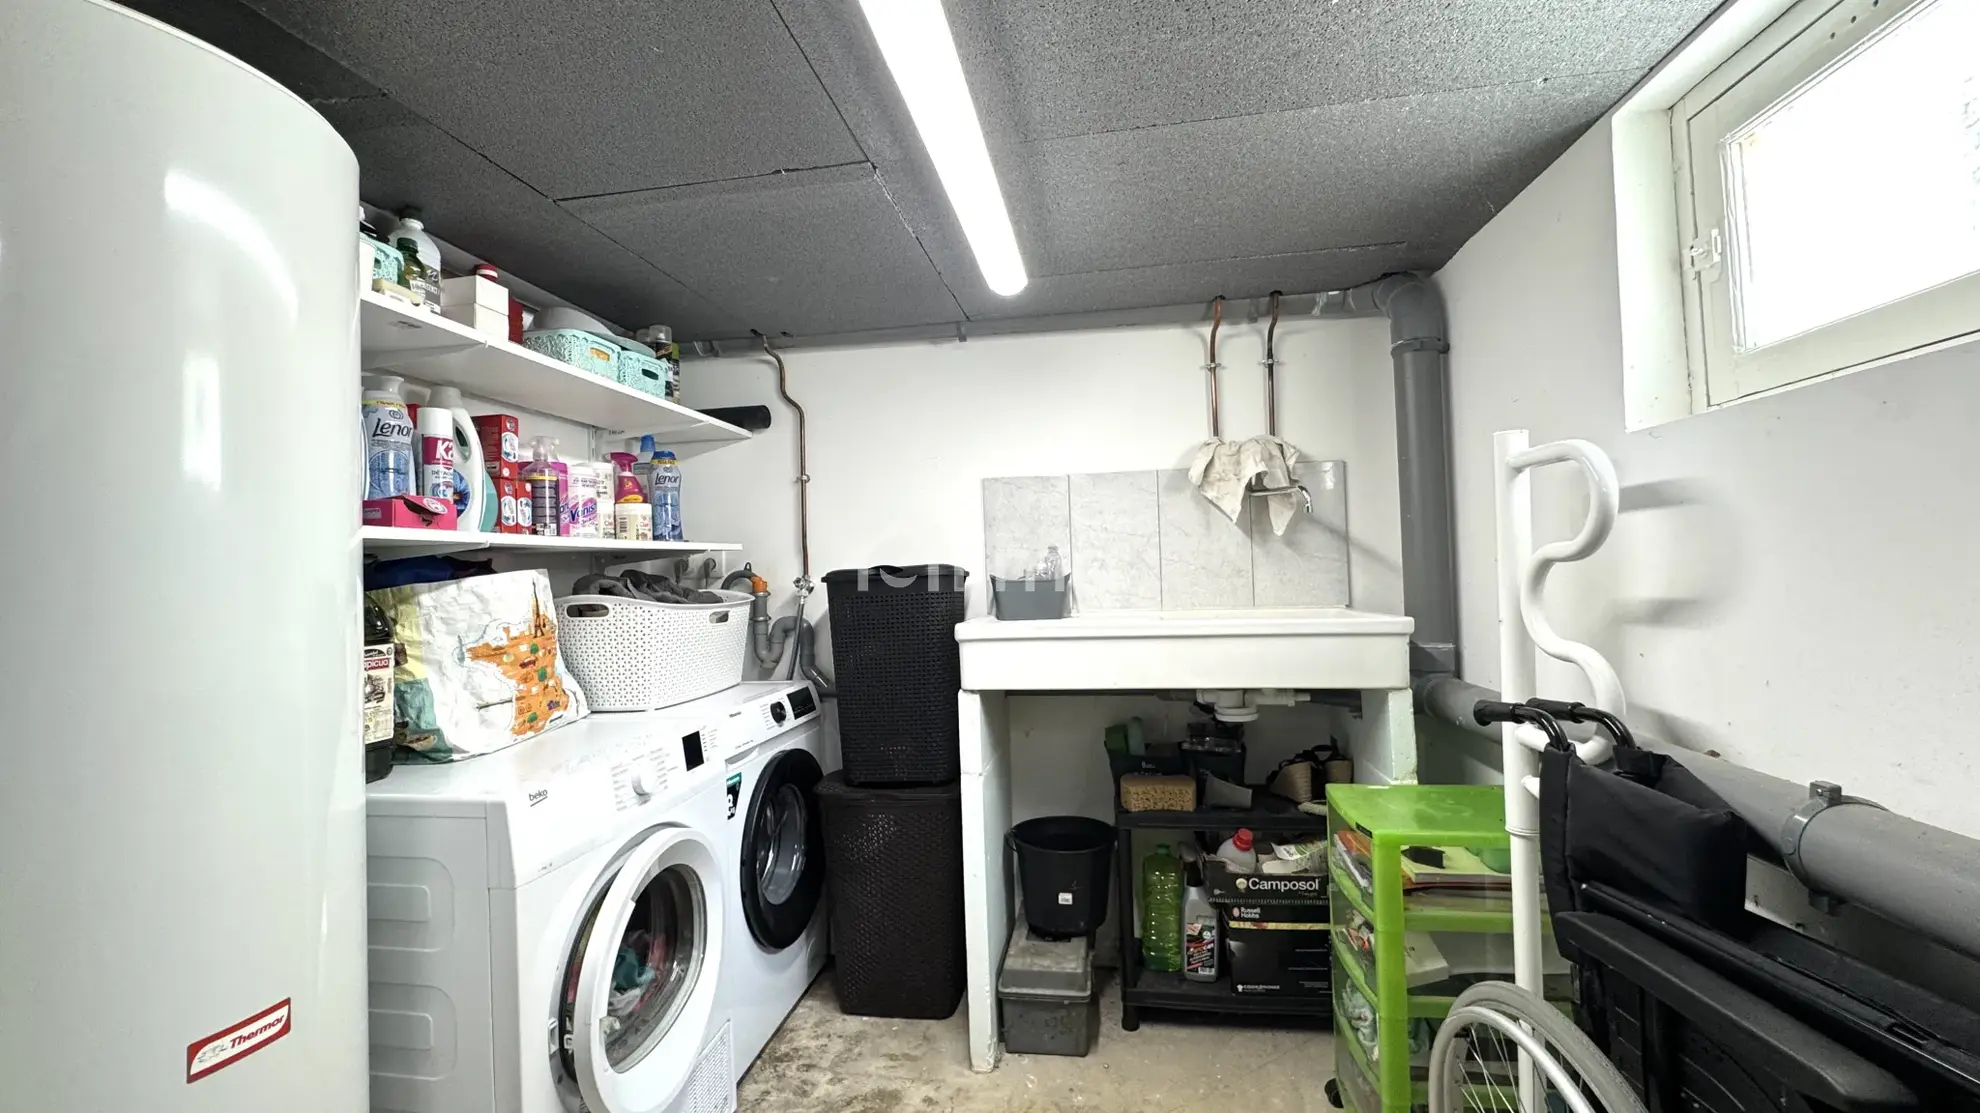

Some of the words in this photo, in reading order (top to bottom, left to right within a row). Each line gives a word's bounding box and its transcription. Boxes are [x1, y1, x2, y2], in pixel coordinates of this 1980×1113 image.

[372, 418, 413, 438] Lenor
[654, 473, 680, 486] Lenor
[528, 789, 549, 802] beko
[1248, 877, 1319, 893] Camposol
[229, 1014, 285, 1050] Thermor
